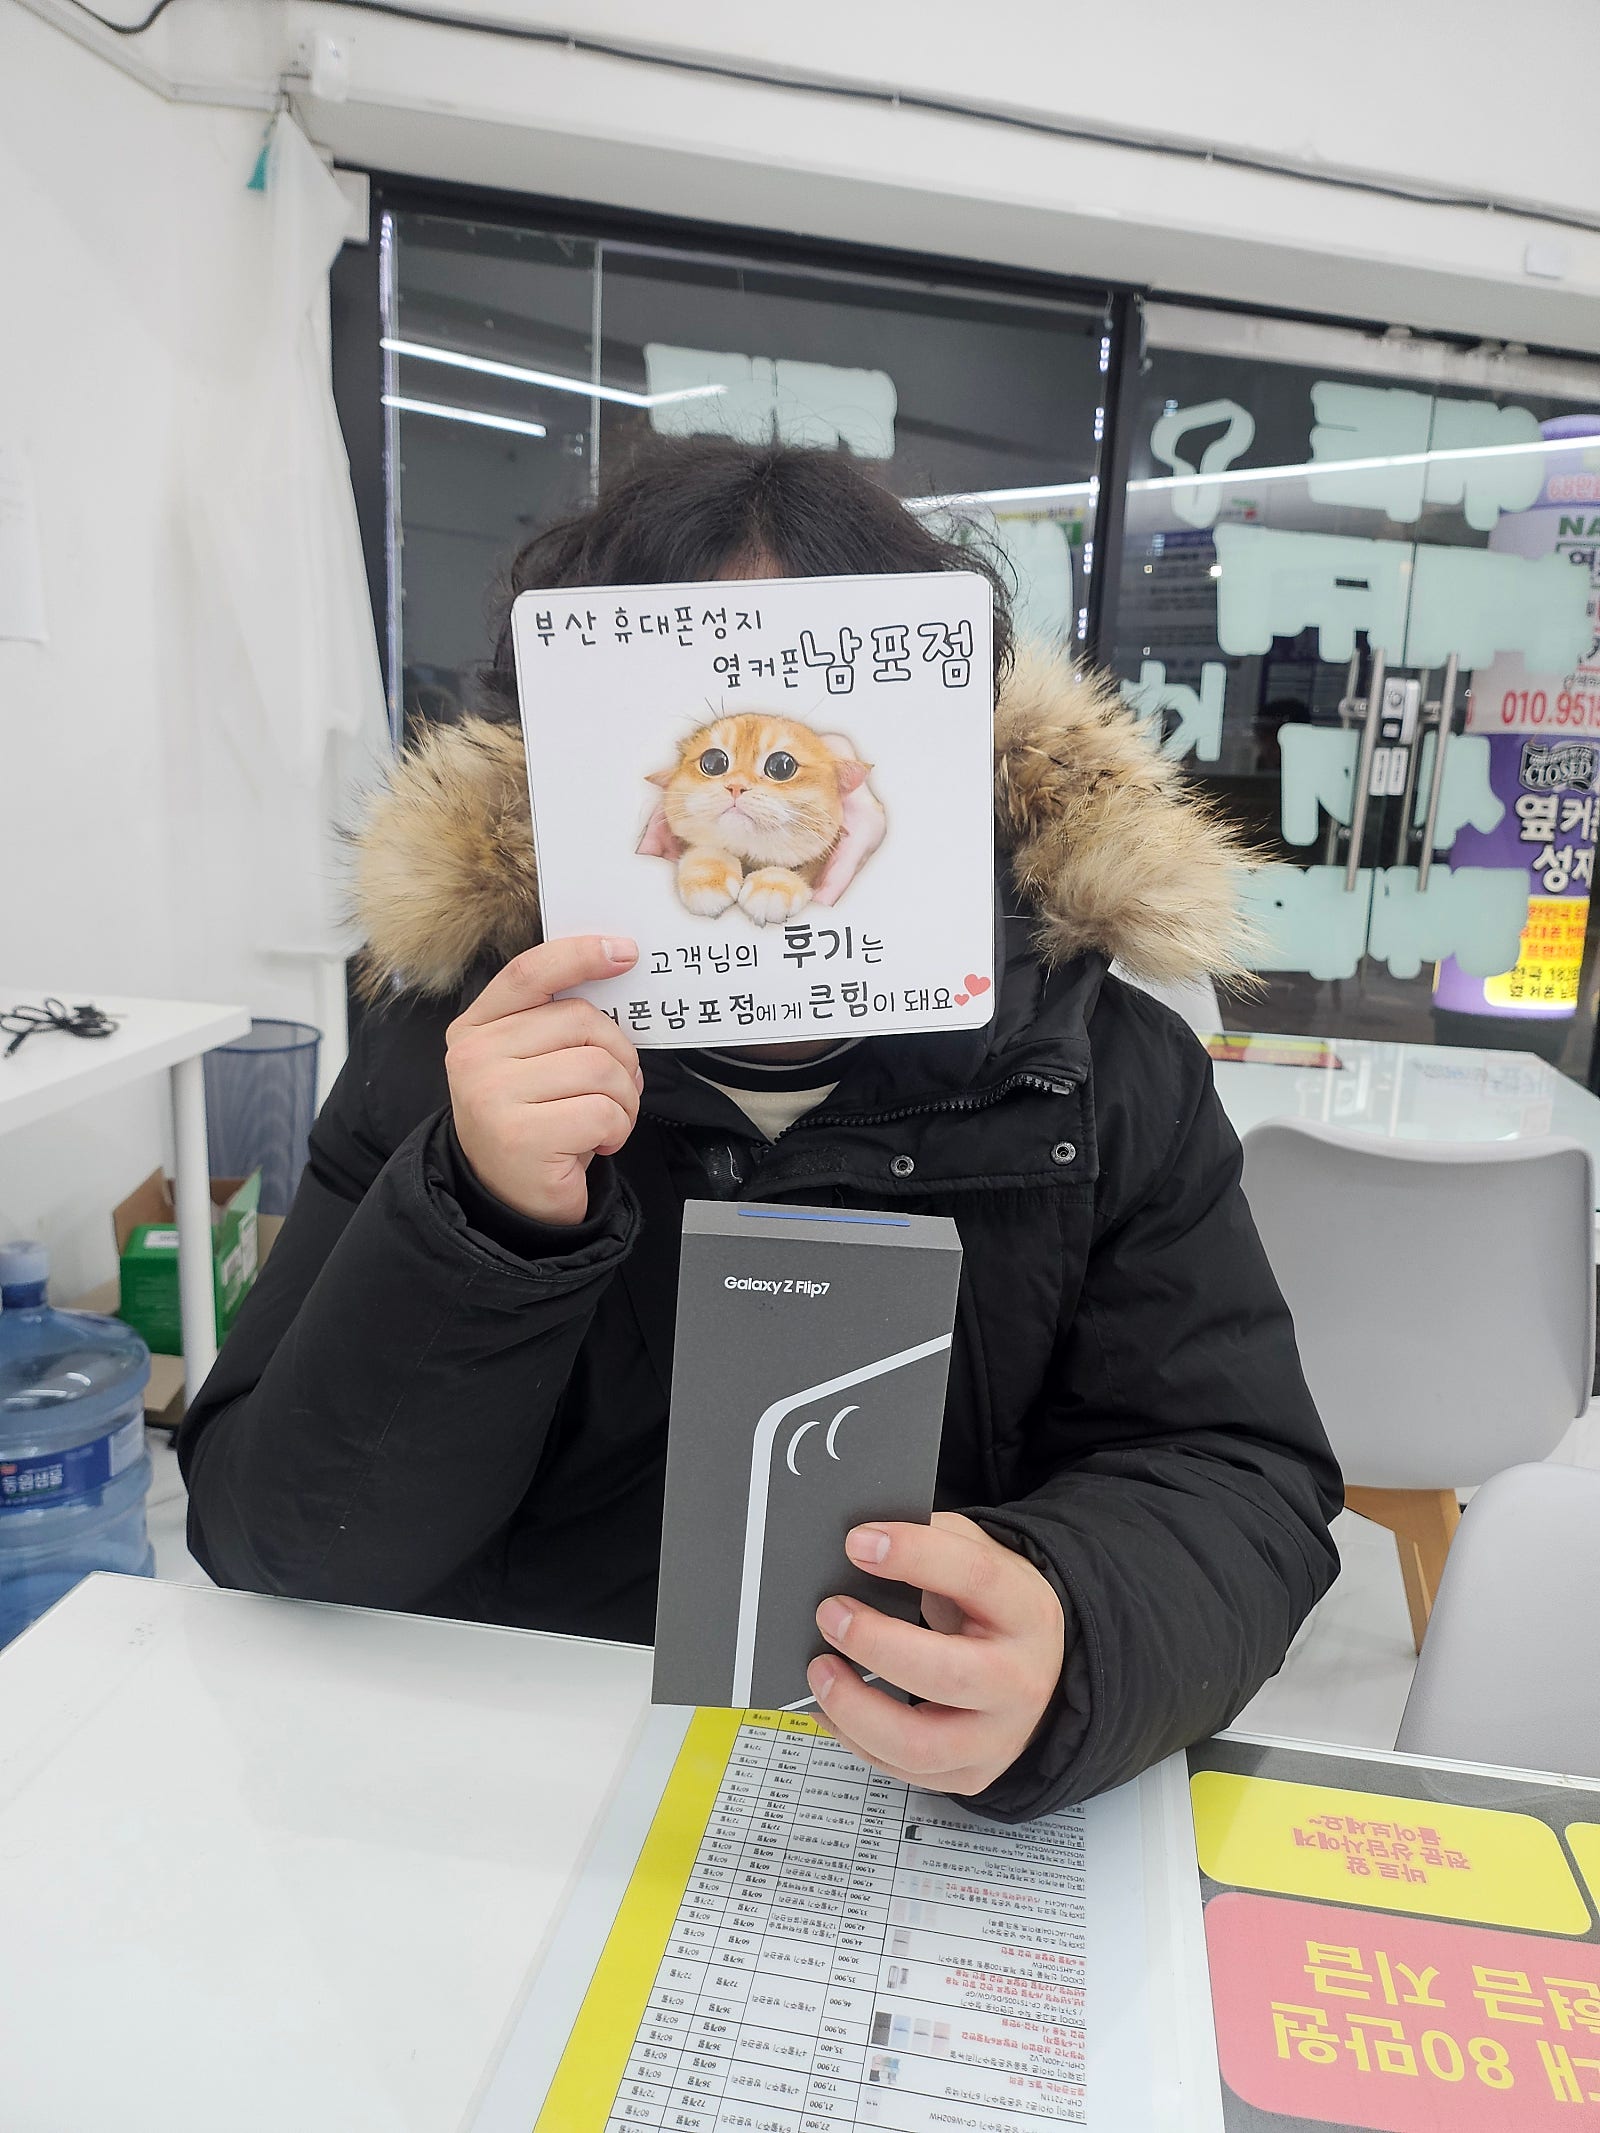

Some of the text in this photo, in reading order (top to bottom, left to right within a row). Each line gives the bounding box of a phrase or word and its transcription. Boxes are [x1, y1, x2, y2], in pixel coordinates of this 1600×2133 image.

[535, 606, 763, 647] 부산 휴대폰성지
[1525, 759, 1591, 786] CLOSED
[649, 923, 884, 976] 고객님의 후기는
[904, 987, 953, 1013] 돼요
[724, 1276, 830, 1297] Galaxy Z Flip7
[1293, 1828, 1469, 1870] 전문 상담사에게
[855, 1865, 875, 1873] 43,900
[1346, 1857, 1427, 1883] 바로 앞
[853, 1879, 873, 1887] 47,900
[850, 1893, 871, 1901] 29,900
[847, 1908, 868, 1916] 33,900
[844, 1922, 866, 1930] 42,900
[841, 1937, 863, 1946] 44,900
[677, 1946, 699, 1955] 60개월
[722, 1953, 745, 1963] 36개월
[838, 1954, 860, 1964] 30,900
[669, 1968, 692, 1979] 72개월
[834, 1974, 856, 1984] 35,900
[715, 1977, 738, 1988] 72개월
[1303, 1940, 1600, 2030] 현금 지급
[661, 1995, 684, 2006] 60개월
[829, 1998, 852, 2009] 46,900
[708, 2003, 732, 2014] 36개월
[655, 2013, 679, 2024] 60개월
[703, 2021, 726, 2032] 60개월
[824, 2024, 847, 2035] 50,900
[649, 2030, 673, 2042] 60개월
[698, 2039, 721, 2051] 36개월
[740, 2038, 770, 2050] 방문관리
[820, 2044, 844, 2054] 35,400
[1271, 2001, 1515, 2089] 80만원
[643, 2048, 667, 2060] 60개월
[693, 2057, 716, 2069] 60개월
[817, 2063, 841, 2073] 37,900
[1030, 2055, 1085, 2070] CHPI-7400N_V2
[637, 2066, 661, 2078] 60개월
[687, 2076, 712, 2088] 36개월
[731, 2075, 761, 2088] 방문관리
[813, 2081, 837, 2091] 17,900
[631, 2086, 655, 2098] 72개월
[681, 2096, 706, 2107] 72개월
[1040, 2093, 1082, 2107] CHP-7211N
[624, 2105, 649, 2117] 60개월
[809, 2101, 834, 2111] 21,900
[676, 2115, 701, 2127] 36개월
[805, 2120, 830, 2131] 27,900
